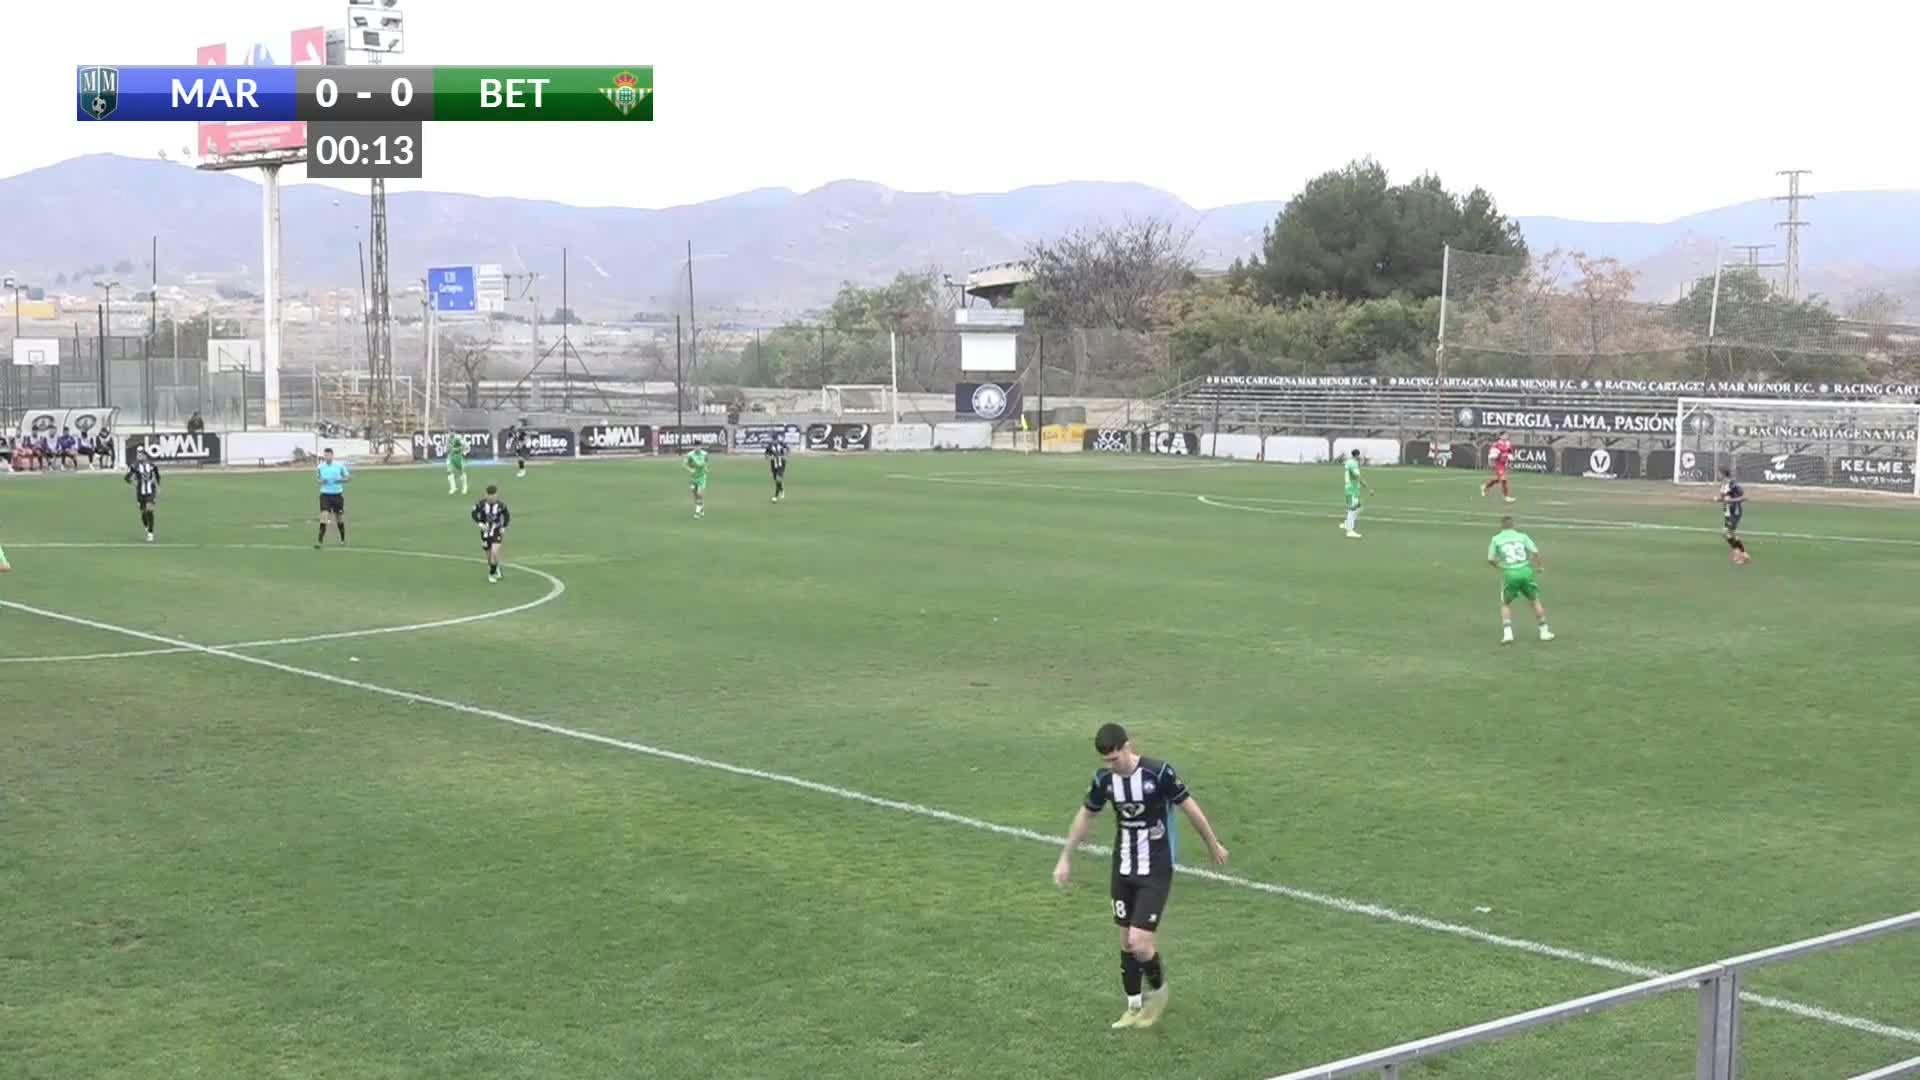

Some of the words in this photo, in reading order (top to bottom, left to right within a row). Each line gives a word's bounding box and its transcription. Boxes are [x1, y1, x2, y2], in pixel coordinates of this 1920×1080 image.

[1246, 376, 1297, 386] CARTAGENA
[1299, 376, 1318, 386] MAR
[1319, 377, 1350, 386] MENOR
[1398, 377, 1434, 387] RACING
[1435, 377, 1493, 388] CARTAGENA
[1494, 378, 1519, 388] MAR
[1520, 378, 1558, 389] MENOR
[1605, 380, 1647, 390] RACING
[1648, 381, 1716, 392] CARTAGEA
[1718, 382, 1745, 392] MAR
[1748, 383, 1791, 393] MENOR
[1834, 384, 1883, 394] RACING
[1750, 426, 1798, 437] RACING
[466, 433, 490, 446] CITY
[1841, 460, 1903, 474] KELME
[1501, 542, 1527, 563] 33
